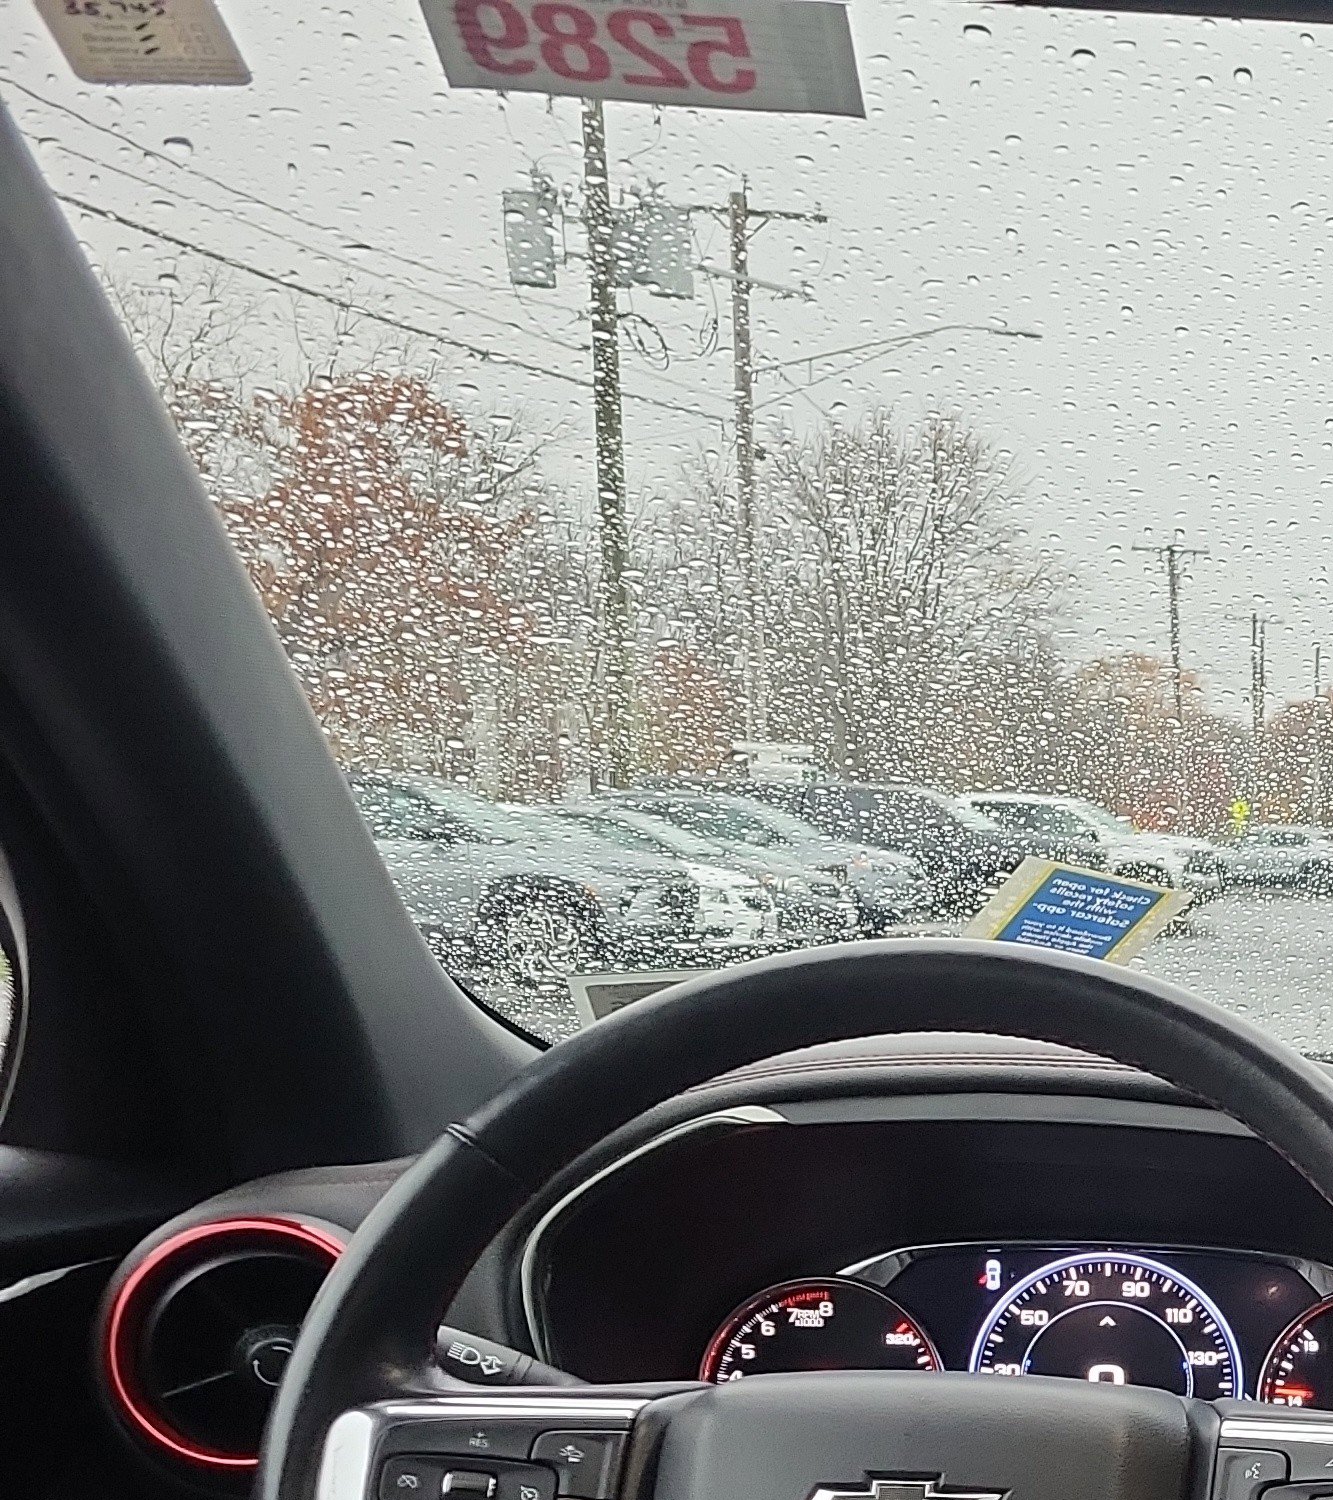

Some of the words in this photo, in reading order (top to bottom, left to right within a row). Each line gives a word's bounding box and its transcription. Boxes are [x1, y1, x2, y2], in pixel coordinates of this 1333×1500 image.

[1063, 1280, 1090, 1297] 70
[1121, 1281, 1150, 1298] 90
[787, 1307, 800, 1323] 7
[798, 1309, 820, 1320] RPM
[819, 1301, 834, 1317] 8
[1020, 1309, 1049, 1325] 50
[1165, 1307, 1193, 1324] 110
[761, 1320, 776, 1336] 6
[741, 1344, 756, 1359] 5
[1187, 1351, 1217, 1366] 130
